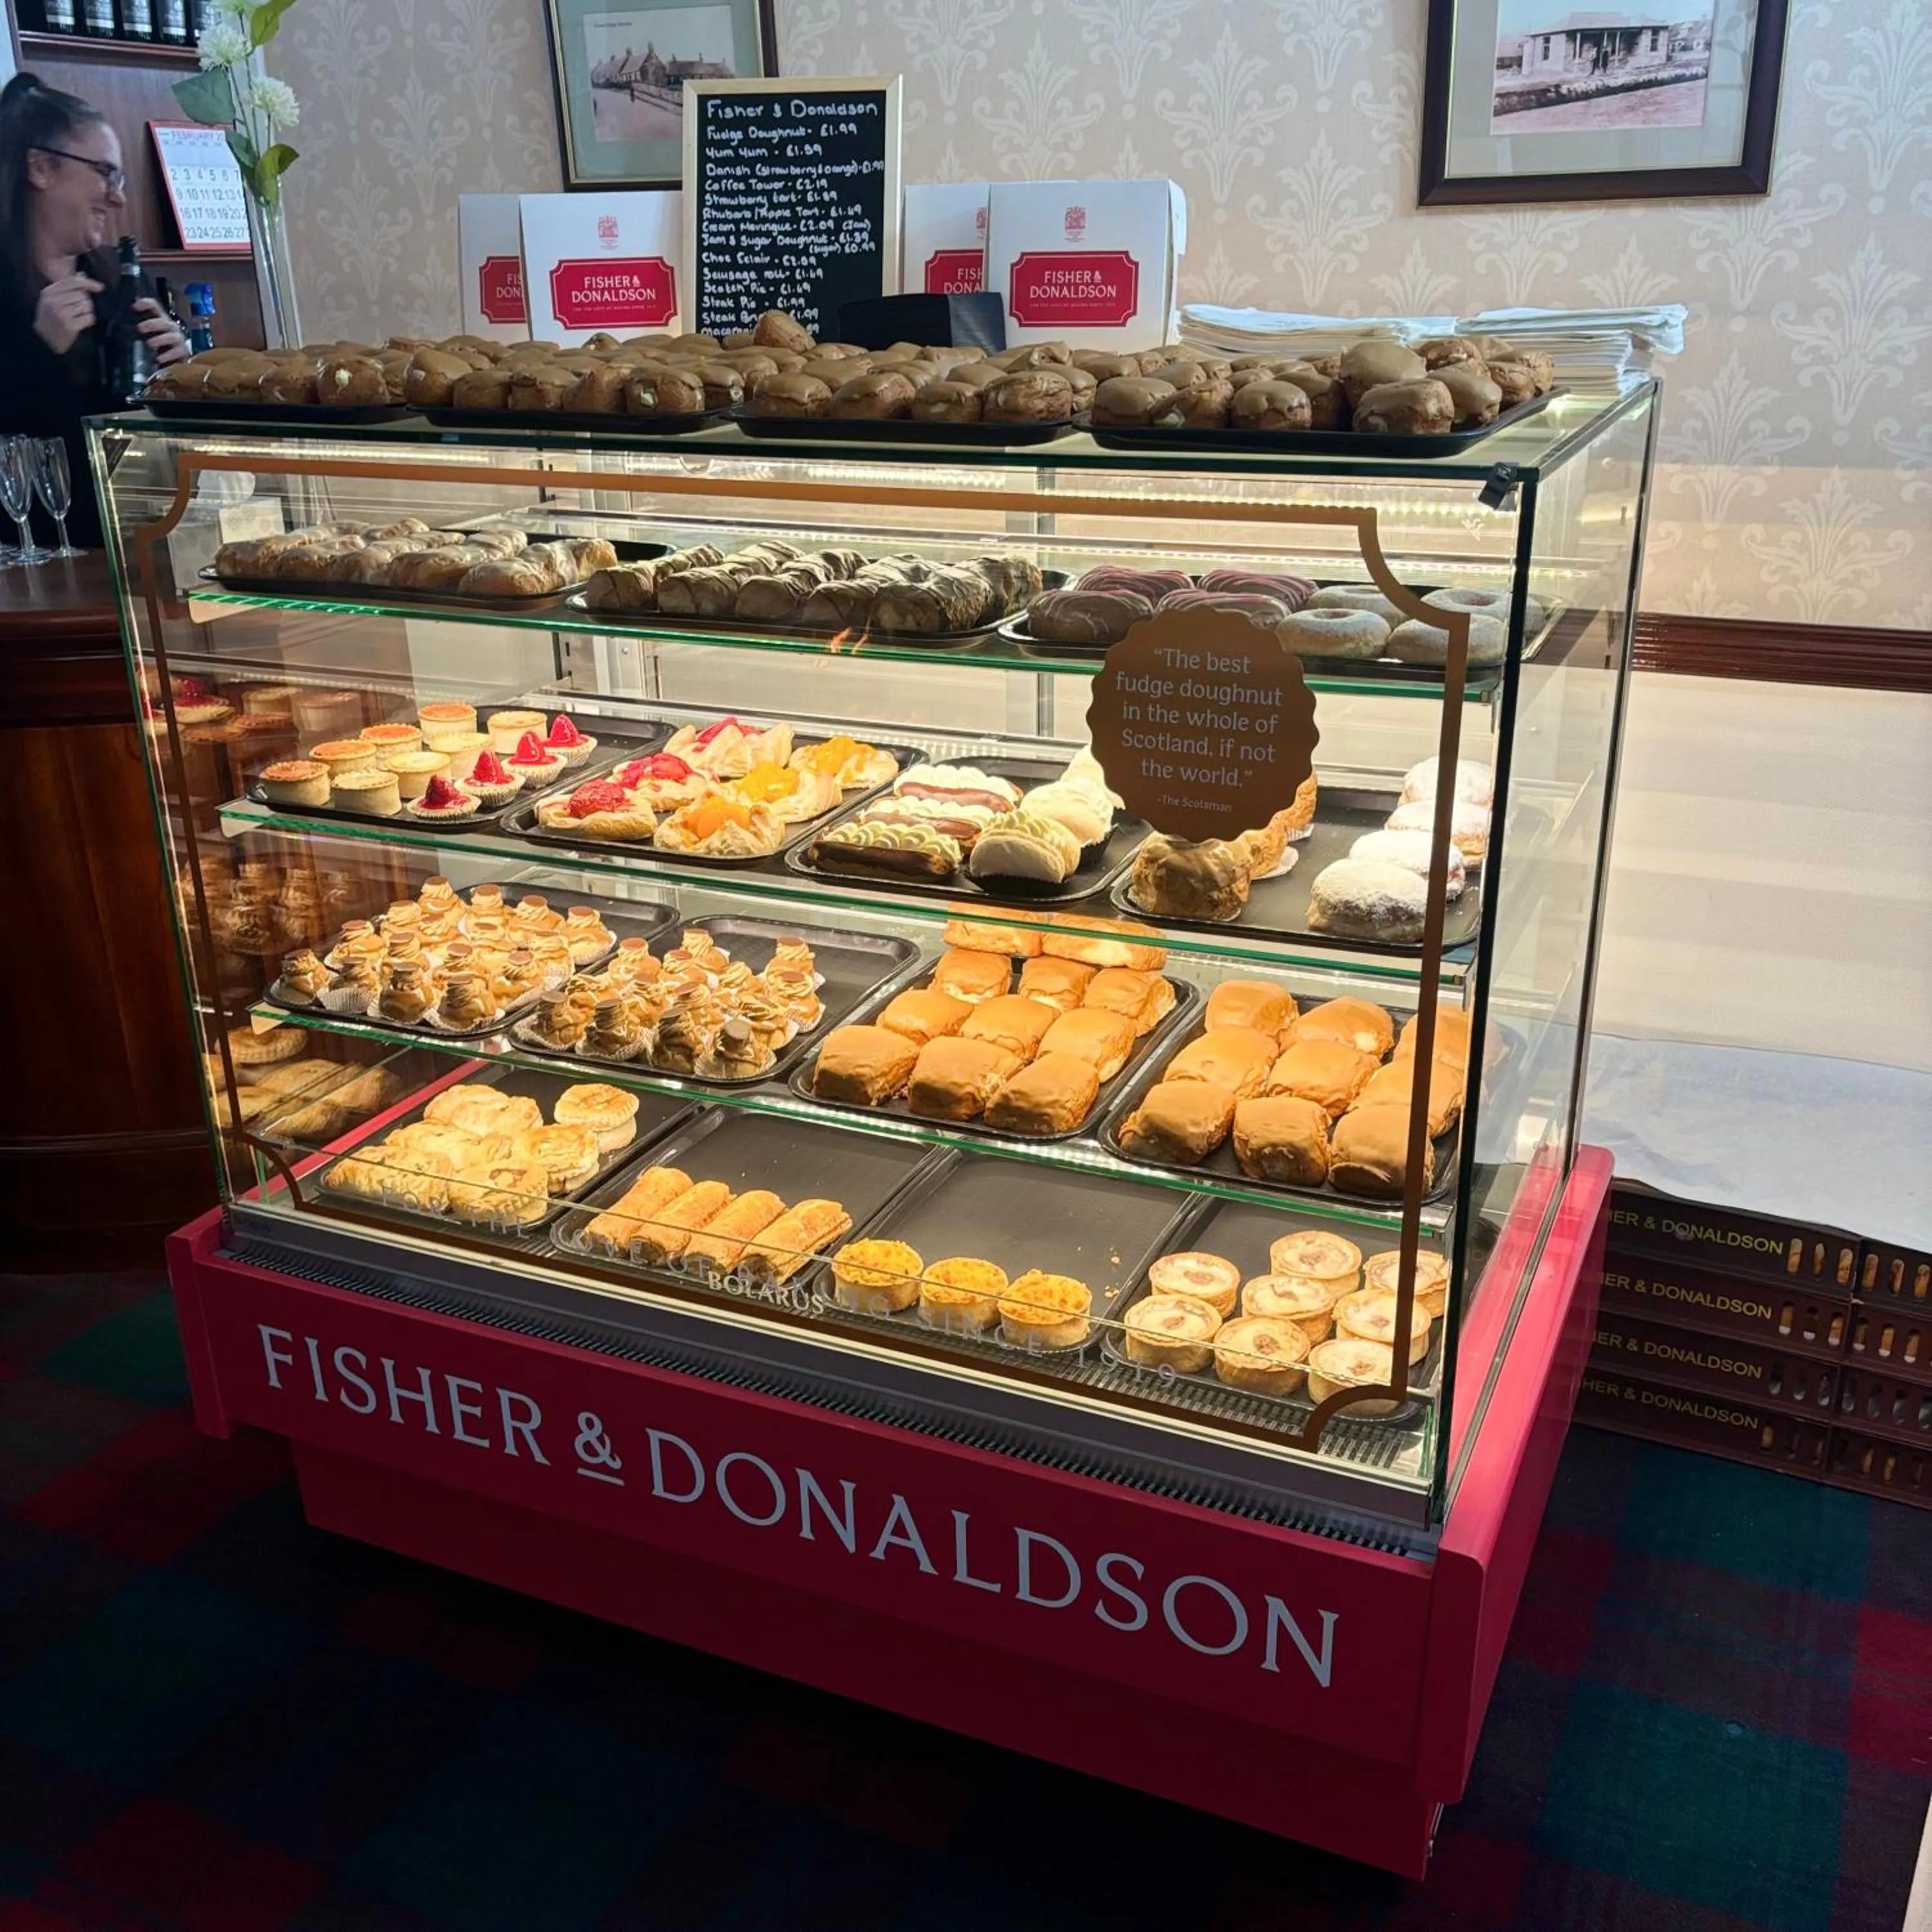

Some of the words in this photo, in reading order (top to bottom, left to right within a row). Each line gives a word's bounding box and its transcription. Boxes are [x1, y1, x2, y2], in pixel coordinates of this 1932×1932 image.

[706, 99, 764, 119] Fisher
[790, 99, 878, 118] Donaldson
[706, 126, 744, 146] Fudge
[820, 122, 858, 137] £1.99
[170, 168, 178, 180] 2
[183, 168, 191, 180] 3
[196, 169, 204, 180] 4
[209, 169, 216, 182] 5
[705, 162, 751, 176] Danish
[704, 178, 746, 191] Coffee
[748, 178, 785, 191] Tower
[795, 178, 828, 191] £2.19
[186, 188, 199, 200] 10
[200, 189, 211, 200] 11
[211, 189, 225, 200] 12
[225, 189, 236, 200] 13
[704, 193, 768, 209] Strawberry
[180, 207, 192, 219] 16
[193, 207, 204, 219] 17
[217, 208, 229, 220] 19
[229, 209, 241, 220] 20
[184, 227, 196, 239] 23
[196, 227, 209, 239] 24
[209, 227, 223, 239] 25
[235, 227, 245, 238] 27
[702, 220, 736, 232] Cream
[799, 219, 835, 232] £2.09
[701, 233, 726, 246] Jam
[701, 252, 732, 264] Choc
[735, 251, 771, 265] Eclair
[584, 276, 630, 289] FISHER
[1044, 270, 1092, 284] FISHER
[571, 288, 657, 303] DONALDSON
[750, 282, 767, 294] Pie
[1030, 284, 1117, 298] DONALDSON
[701, 296, 735, 309] Steak
[739, 296, 757, 309] Pie
[701, 312, 737, 325] Steak
[1206, 651, 1251, 675] best
[1115, 671, 1175, 698] fudge
[1179, 678, 1283, 707] doughnut
[1122, 701, 1141, 720] in
[1148, 703, 1180, 724] the
[1186, 708, 1249, 732] whole
[1255, 714, 1279, 735] of
[1220, 738, 1235, 759] if
[1240, 744, 1277, 764] not
[1141, 757, 1174, 779] the
[1182, 797, 1233, 813] Scotsman
[1643, 1215, 1656, 1231] &
[1662, 1220, 1784, 1256] DONALDSON
[708, 1271, 824, 1314] BOLARUS
[1634, 1278, 1647, 1294] &
[1652, 1282, 1772, 1320] DONALDSON
[1625, 1337, 1640, 1352] &
[1643, 1341, 1763, 1379] DONALDSON
[1077, 1347, 1176, 1388] 1919
[1623, 1386, 1638, 1401] &
[1641, 1392, 1759, 1430] DONALDSON
[257, 1323, 552, 1466] FISHER
[574, 1410, 626, 1487] &
[644, 1427, 1340, 1689] DONALDSON
